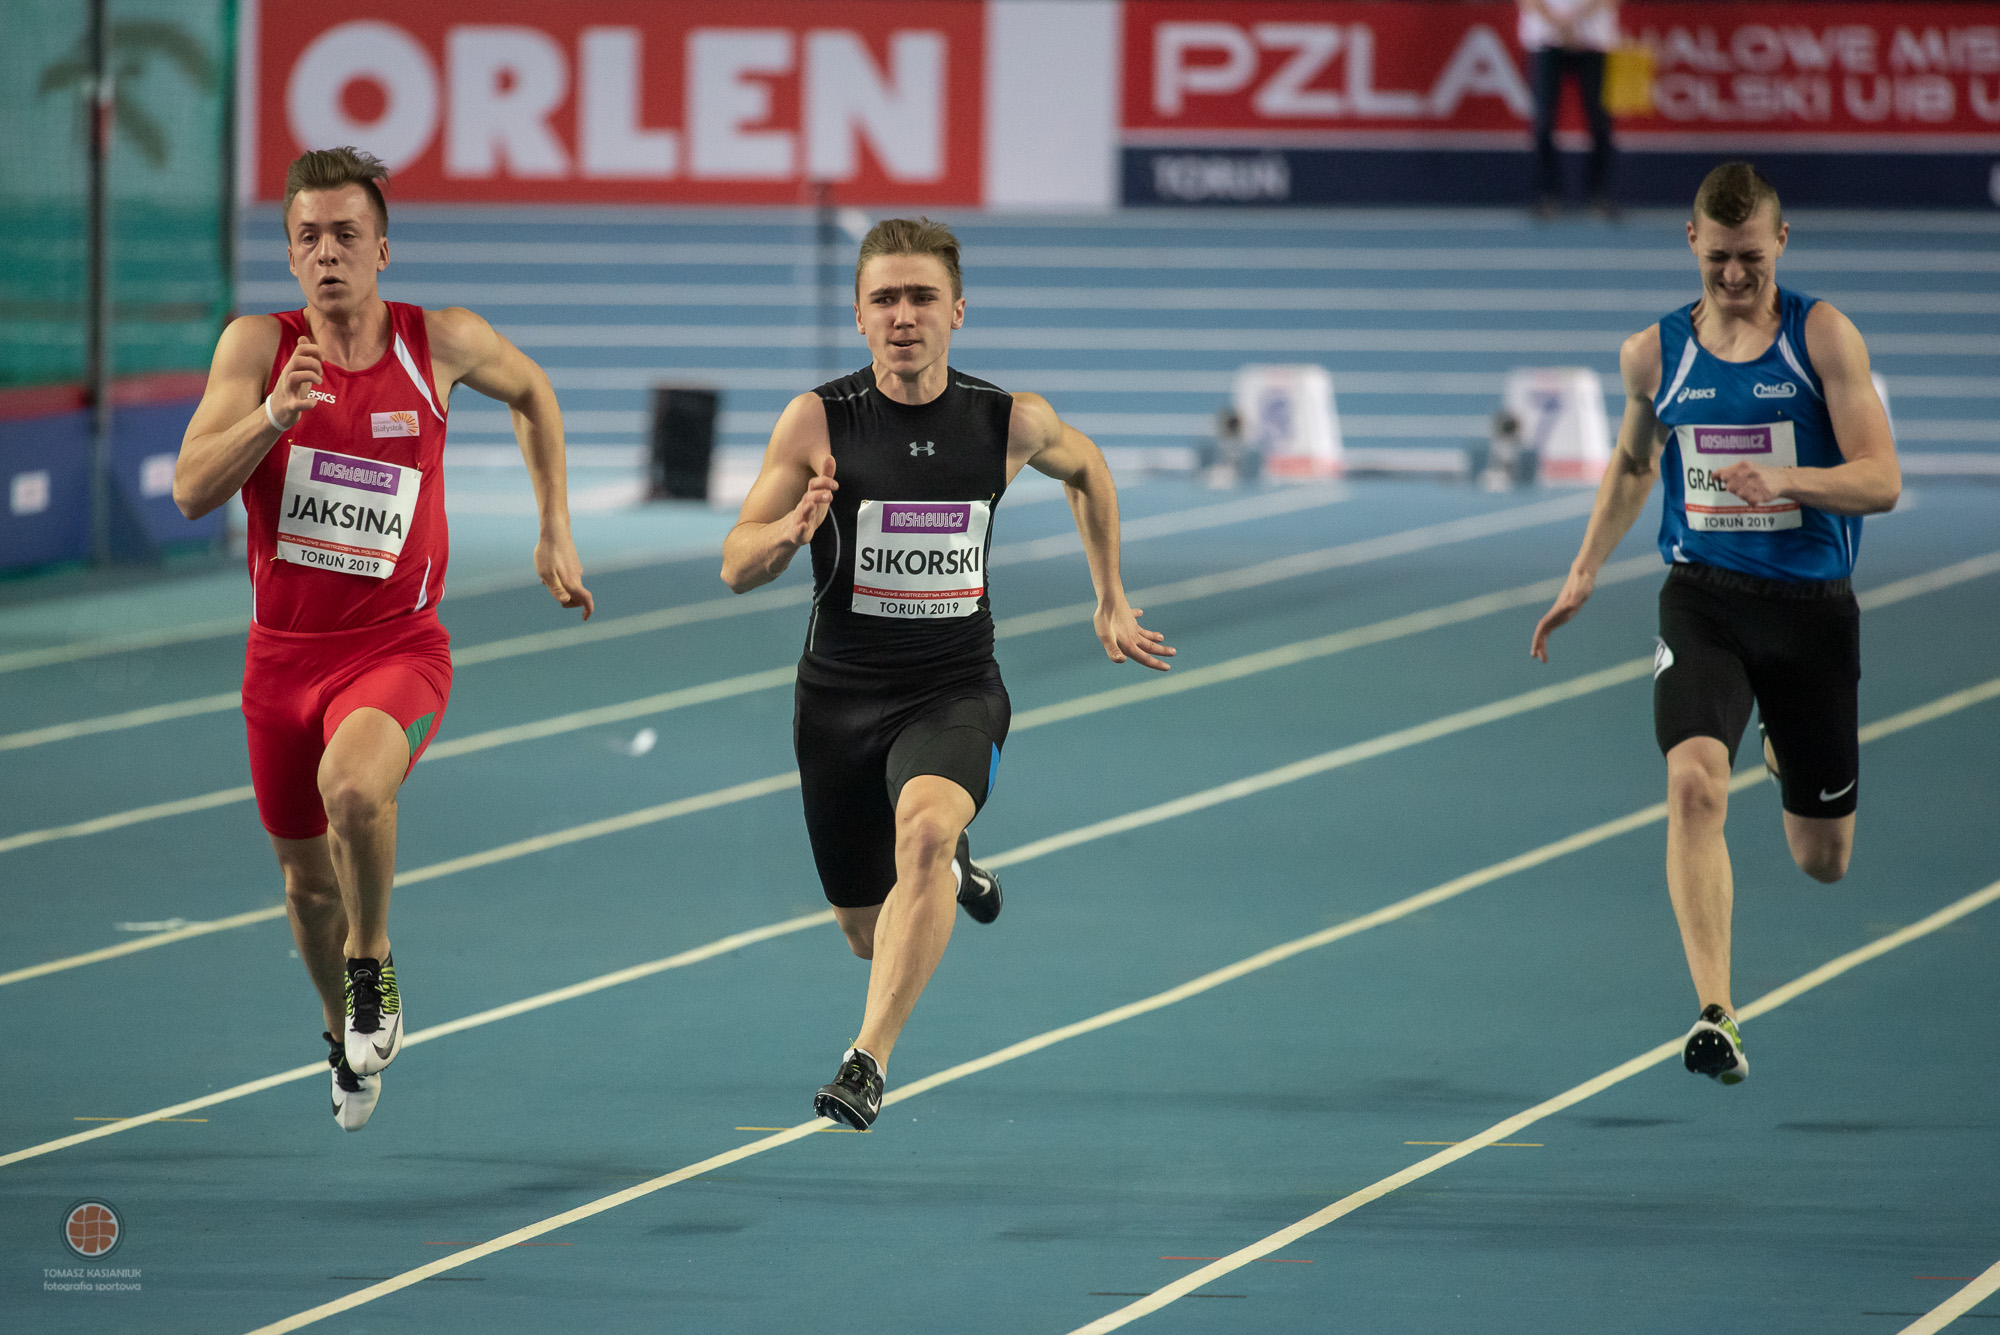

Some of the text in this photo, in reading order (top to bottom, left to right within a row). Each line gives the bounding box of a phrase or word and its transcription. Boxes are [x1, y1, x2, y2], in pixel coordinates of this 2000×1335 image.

[1151, 21, 1536, 119] PZLA
[285, 19, 948, 184] ORLEN
[1650, 73, 1832, 122] OLSKI
[307, 389, 336, 404] asics
[1688, 387, 1716, 400] asics
[319, 461, 394, 488] noskiewicz
[287, 494, 402, 540] JAKSINA
[890, 512, 964, 528] noskiewicz
[1748, 517, 1775, 528] 2019
[320, 542, 360, 554] MISTRZOSTWA
[301, 549, 380, 573] TORUŃ 2019
[860, 546, 980, 575] SIKORSKI
[880, 600, 959, 615] TORUŃ 2019
